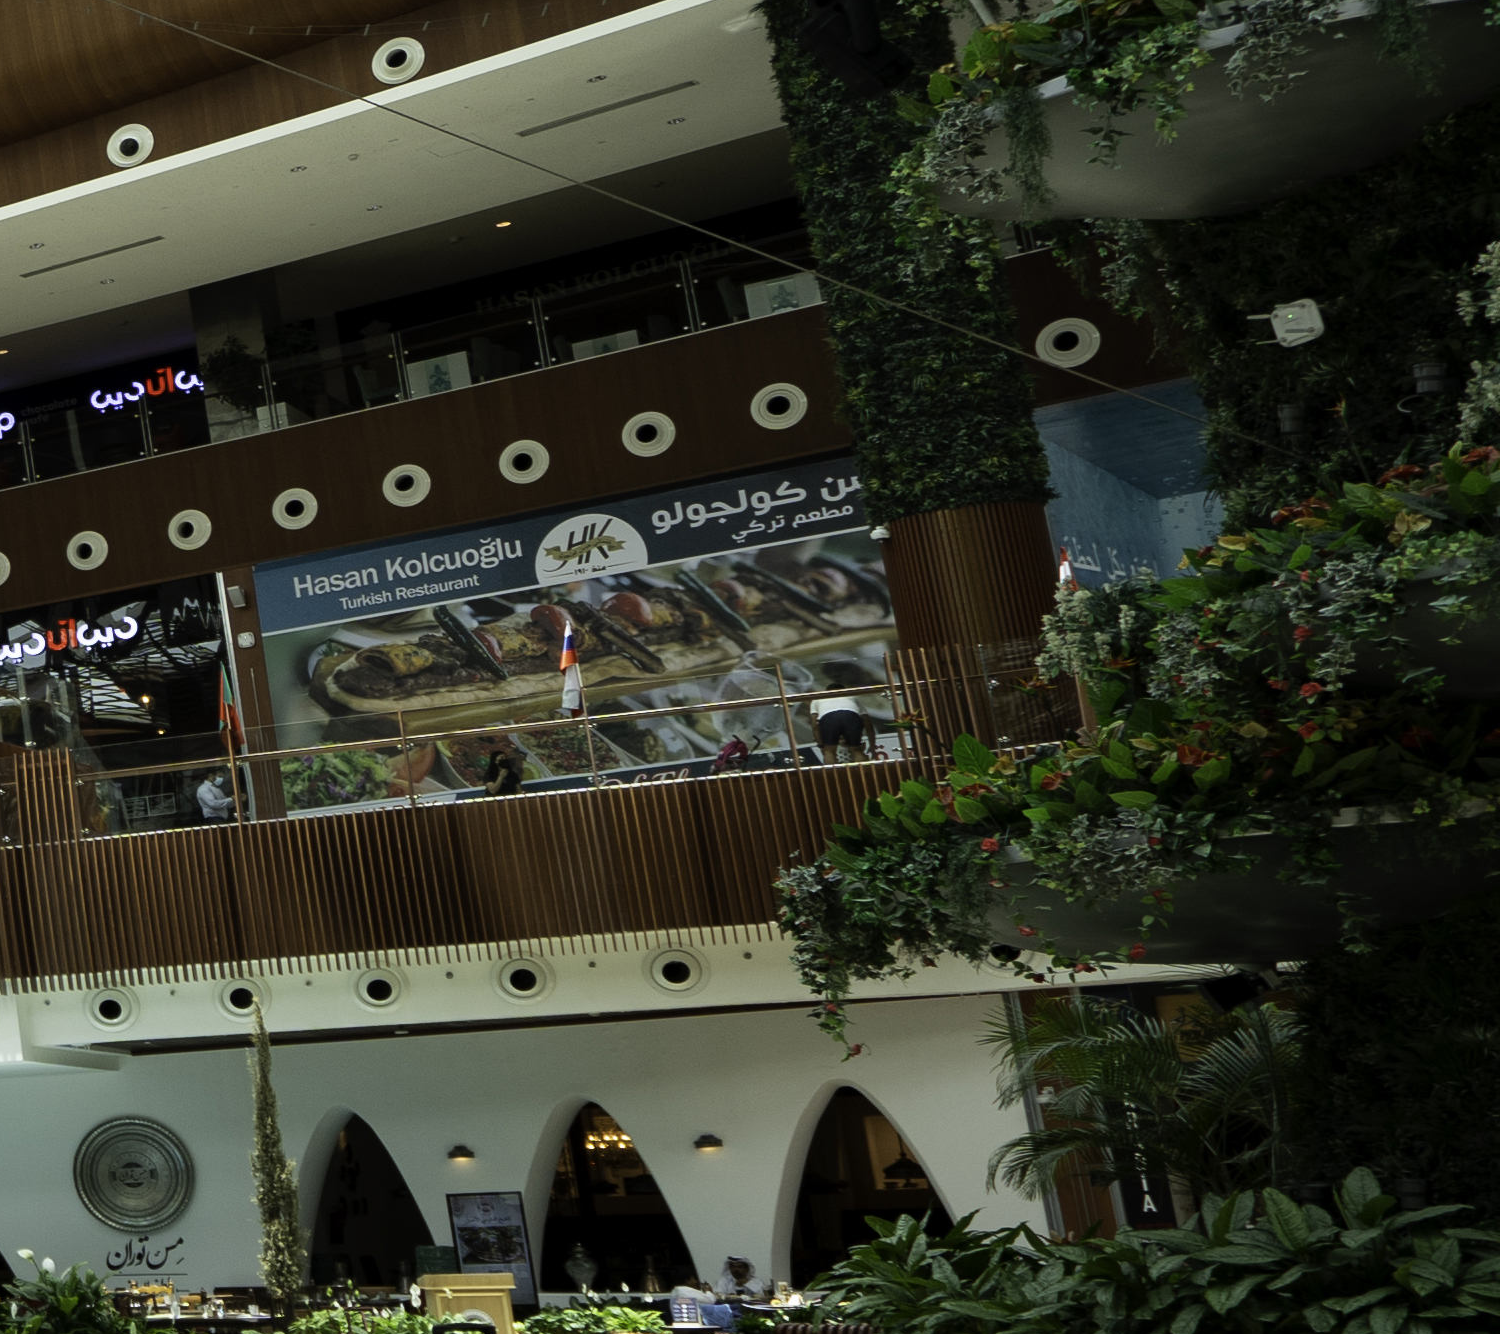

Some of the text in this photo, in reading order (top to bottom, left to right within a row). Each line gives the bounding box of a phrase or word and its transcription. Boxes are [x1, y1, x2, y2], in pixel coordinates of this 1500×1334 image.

[731, 504, 855, 544] مطعم تركي
[293, 566, 380, 599] Hasan
[384, 536, 523, 582] Kolcuoğlu
[338, 573, 480, 611] Turkish Restaurant
